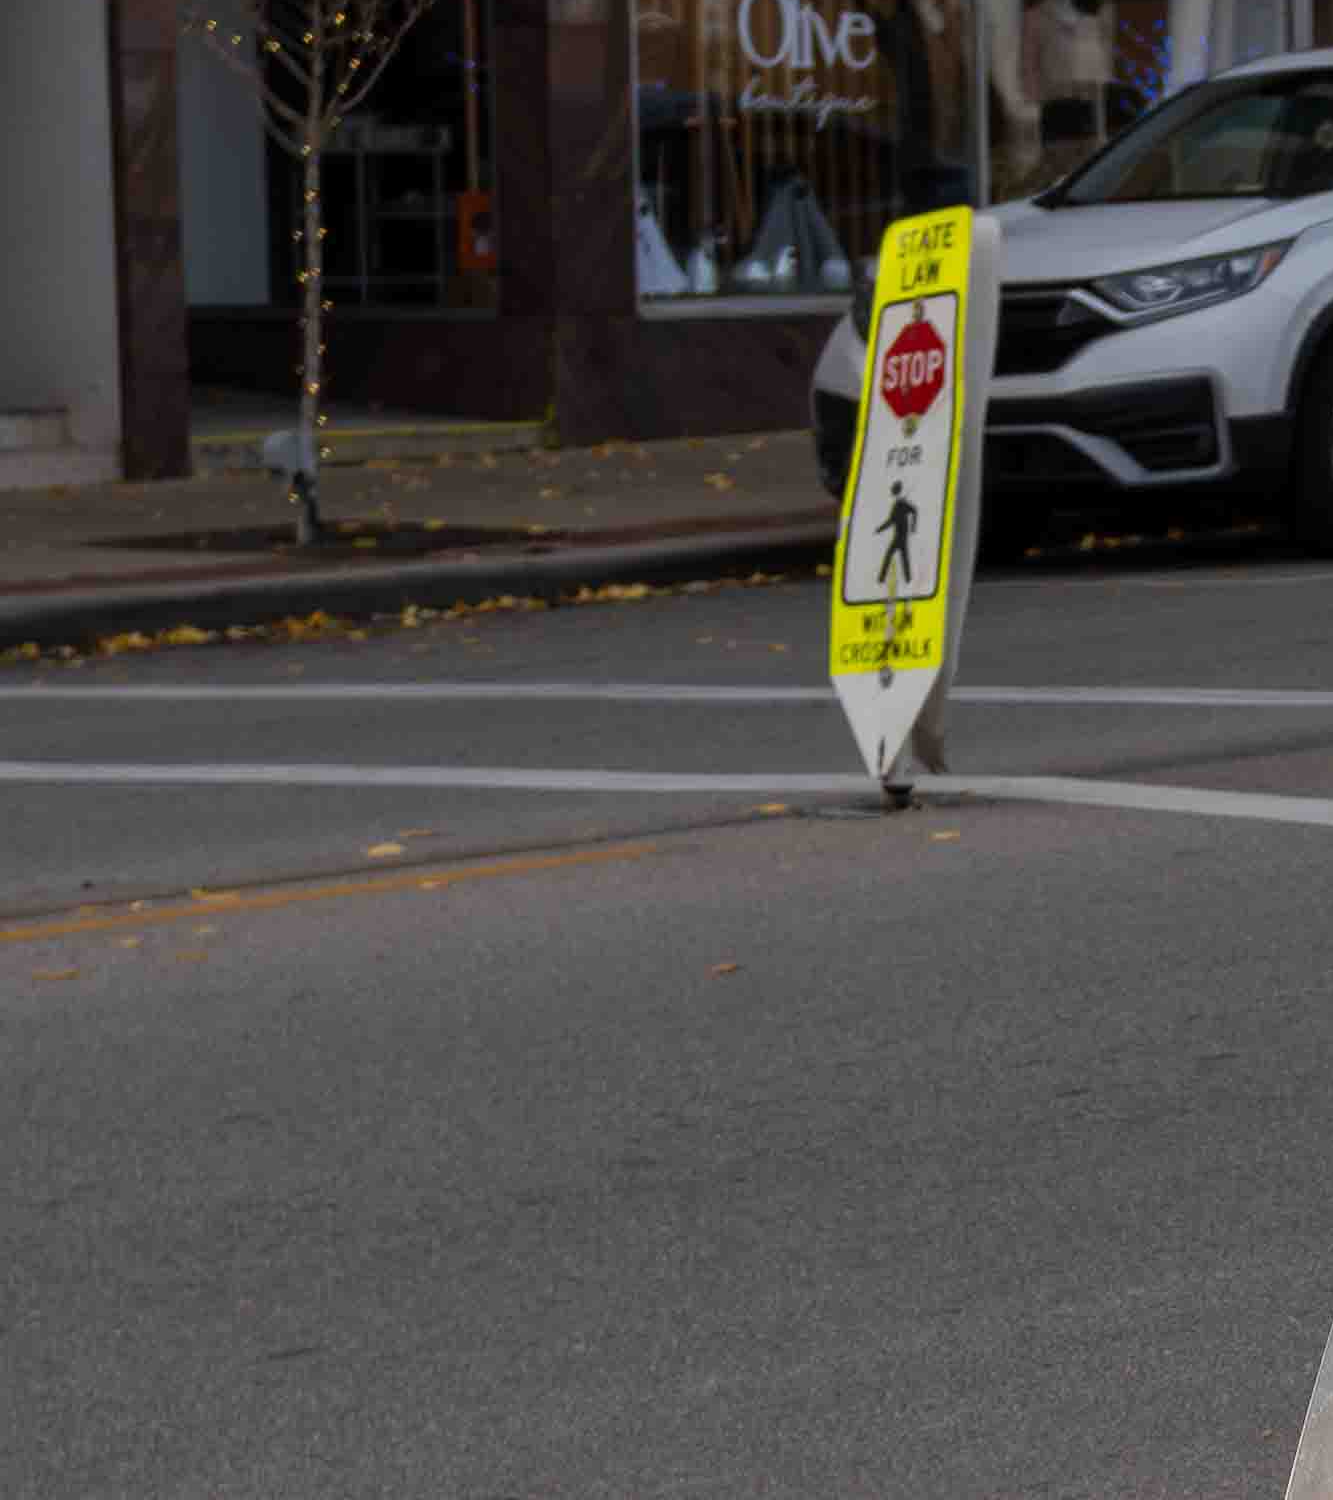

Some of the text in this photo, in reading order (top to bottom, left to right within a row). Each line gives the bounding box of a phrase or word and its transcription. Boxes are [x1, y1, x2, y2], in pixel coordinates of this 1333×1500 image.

[896, 221, 957, 260] STATE
[900, 260, 941, 292] LAW
[883, 349, 944, 392] STOP
[886, 444, 923, 468] FOR
